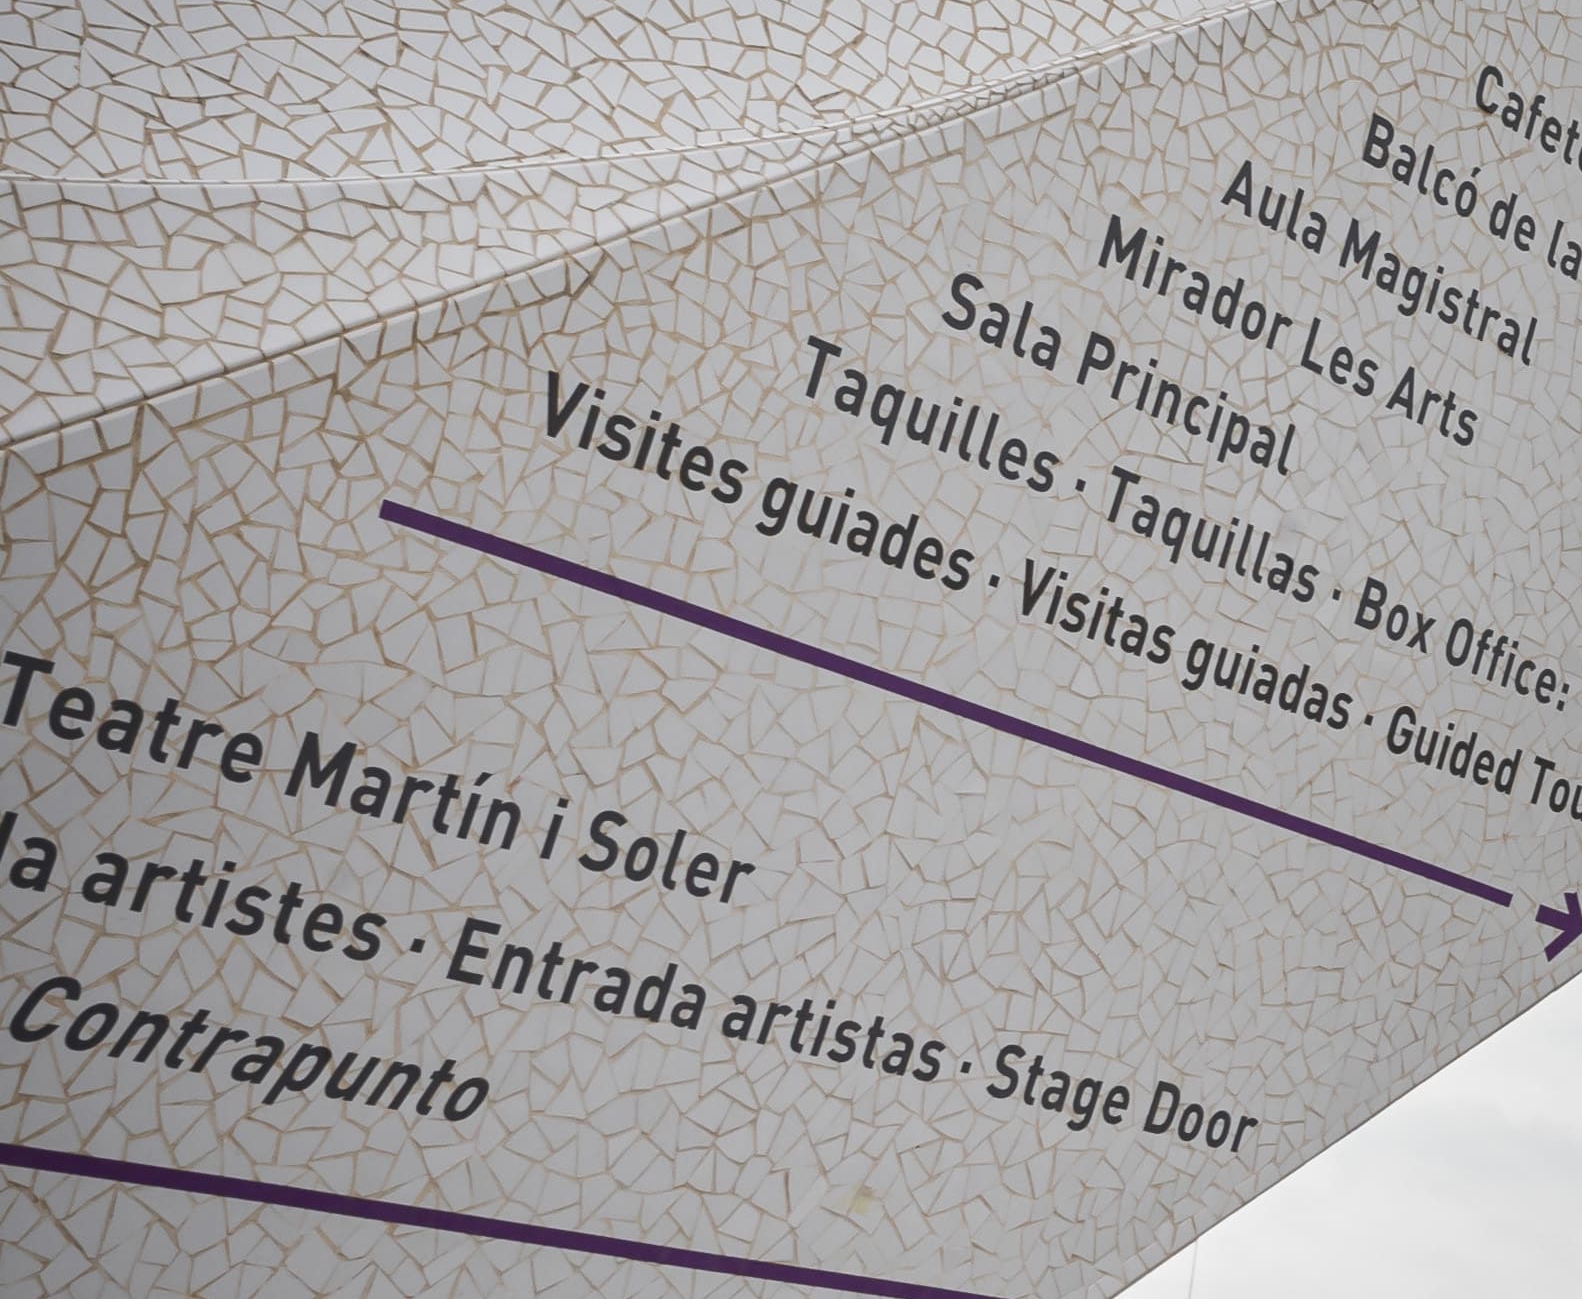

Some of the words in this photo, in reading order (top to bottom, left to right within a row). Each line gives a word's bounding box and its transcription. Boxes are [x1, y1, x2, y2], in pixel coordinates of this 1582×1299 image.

[1221, 161, 1326, 253] Aula
[1340, 218, 1537, 365] Magistral
[1363, 113, 1480, 217] Balcó
[1490, 193, 1535, 251] de
[1548, 220, 1582, 280] la
[942, 274, 1060, 370] Sala
[1077, 332, 1295, 475] Principal
[1099, 215, 1293, 349] Mirador
[1301, 318, 1378, 396] Les
[1386, 367, 1477, 446] Arts
[547, 371, 748, 503] Visites
[756, 478, 977, 590] guiades
[1023, 559, 1175, 663] Visitas
[1182, 639, 1354, 729] guiadas
[1387, 706, 1522, 794] Guided
[806, 336, 1061, 492] Taquilles
[1108, 466, 1319, 602] Taquillas
[1354, 577, 1436, 653] Box
[1446, 619, 1569, 711] Office:
[3, 651, 262, 783] Teatre
[285, 732, 520, 849] Martín
[540, 798, 569, 859] i
[579, 811, 755, 903] Soler
[7, 976, 489, 1121] Contrapunto
[81, 852, 387, 960] artistes
[447, 918, 705, 1029] Entrada
[722, 995, 946, 1081] artistas
[987, 1045, 1129, 1131] Stage
[1144, 1081, 1258, 1152] Door
